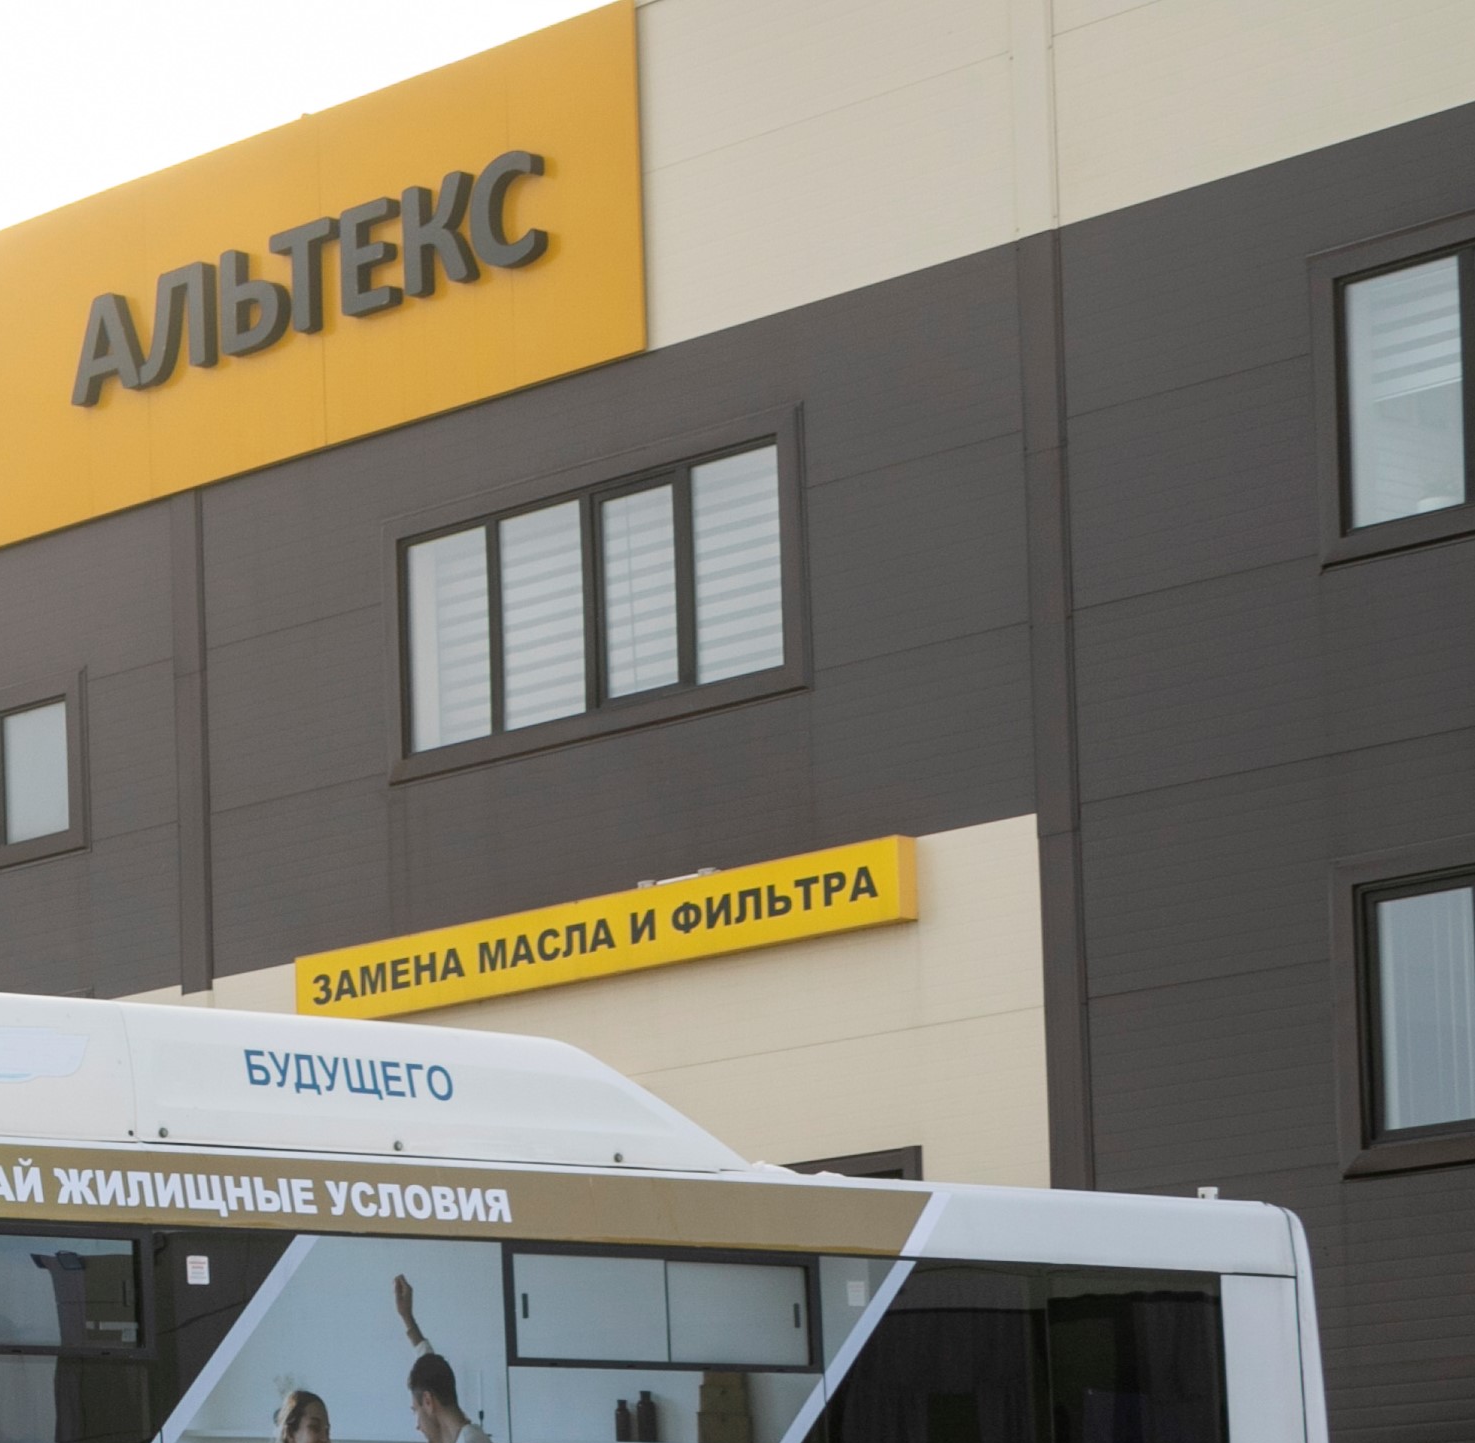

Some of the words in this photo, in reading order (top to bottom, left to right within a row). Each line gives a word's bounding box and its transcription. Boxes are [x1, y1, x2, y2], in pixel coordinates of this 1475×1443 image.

[70, 150, 549, 407] АЛЬТЕКС
[312, 947, 466, 1005] ЗАМЕНА
[477, 918, 616, 975] МАСЛА
[630, 911, 656, 945] И
[671, 865, 879, 935] ФИЛЬТРА
[244, 1049, 454, 1101] БУДУЩЕГО
[53, 1167, 318, 1217] ЖИЛИЩНЫЕ
[326, 1180, 513, 1224] УСЛОВИЯ
